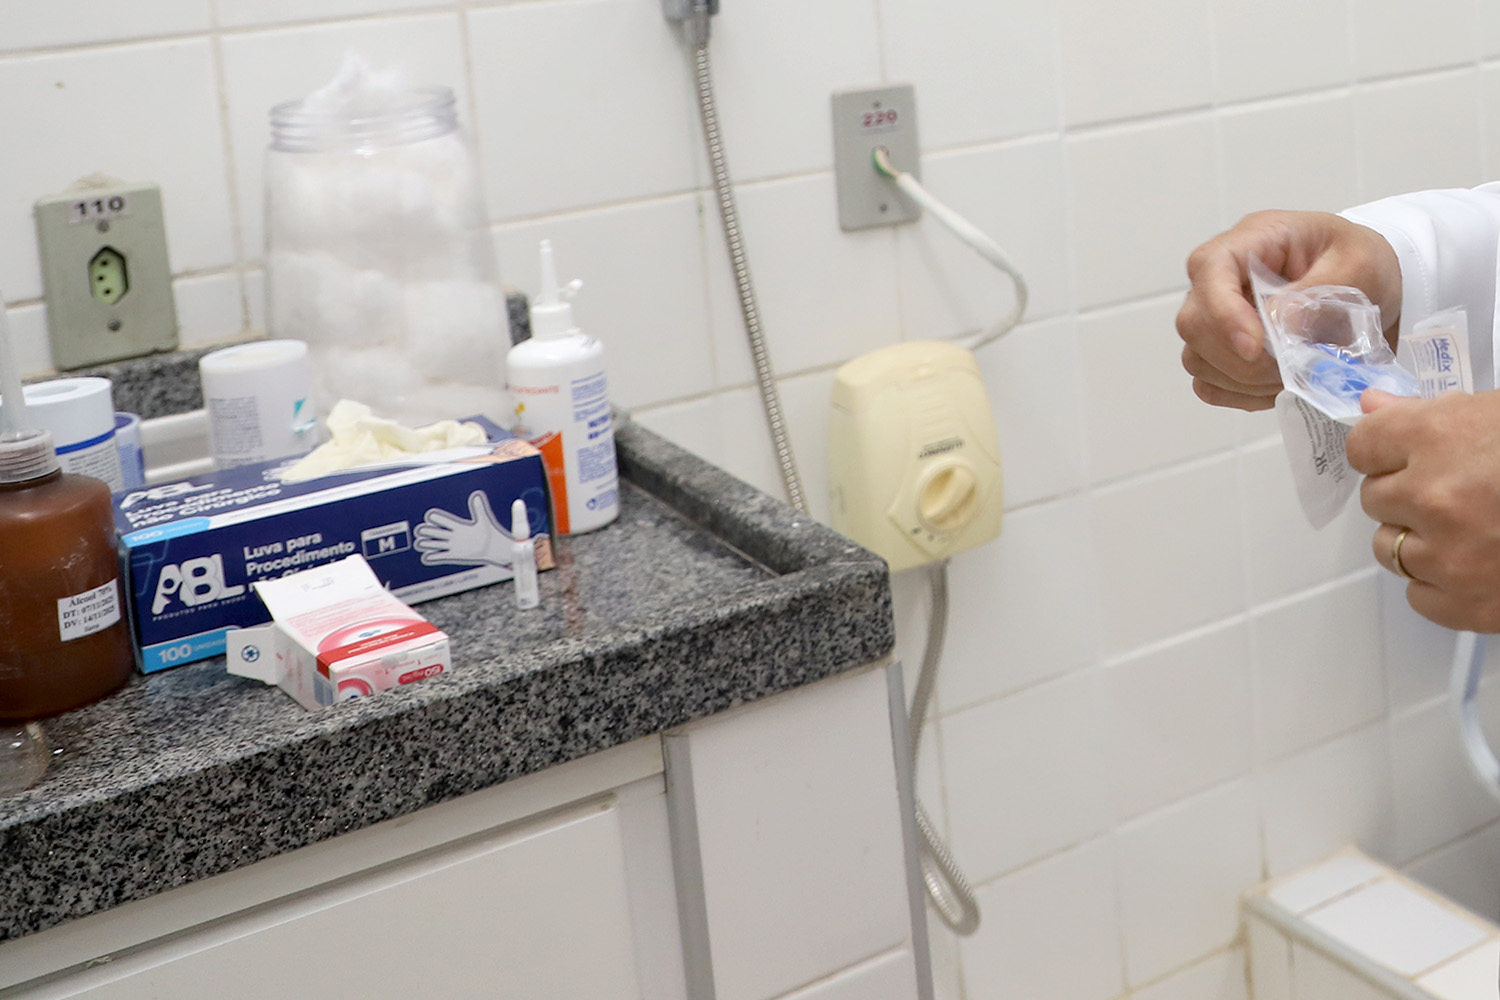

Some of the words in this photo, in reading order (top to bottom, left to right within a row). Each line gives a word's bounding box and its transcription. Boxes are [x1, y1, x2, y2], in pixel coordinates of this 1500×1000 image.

[863, 109, 898, 127] 220
[74, 196, 124, 215] 110
[1437, 337, 1454, 372] Medix
[243, 541, 283, 561] Luva
[286, 532, 323, 553] para
[378, 535, 396, 552] M
[246, 540, 356, 577] Procedimento
[151, 553, 246, 615] ABL
[158, 643, 193, 663] 100
